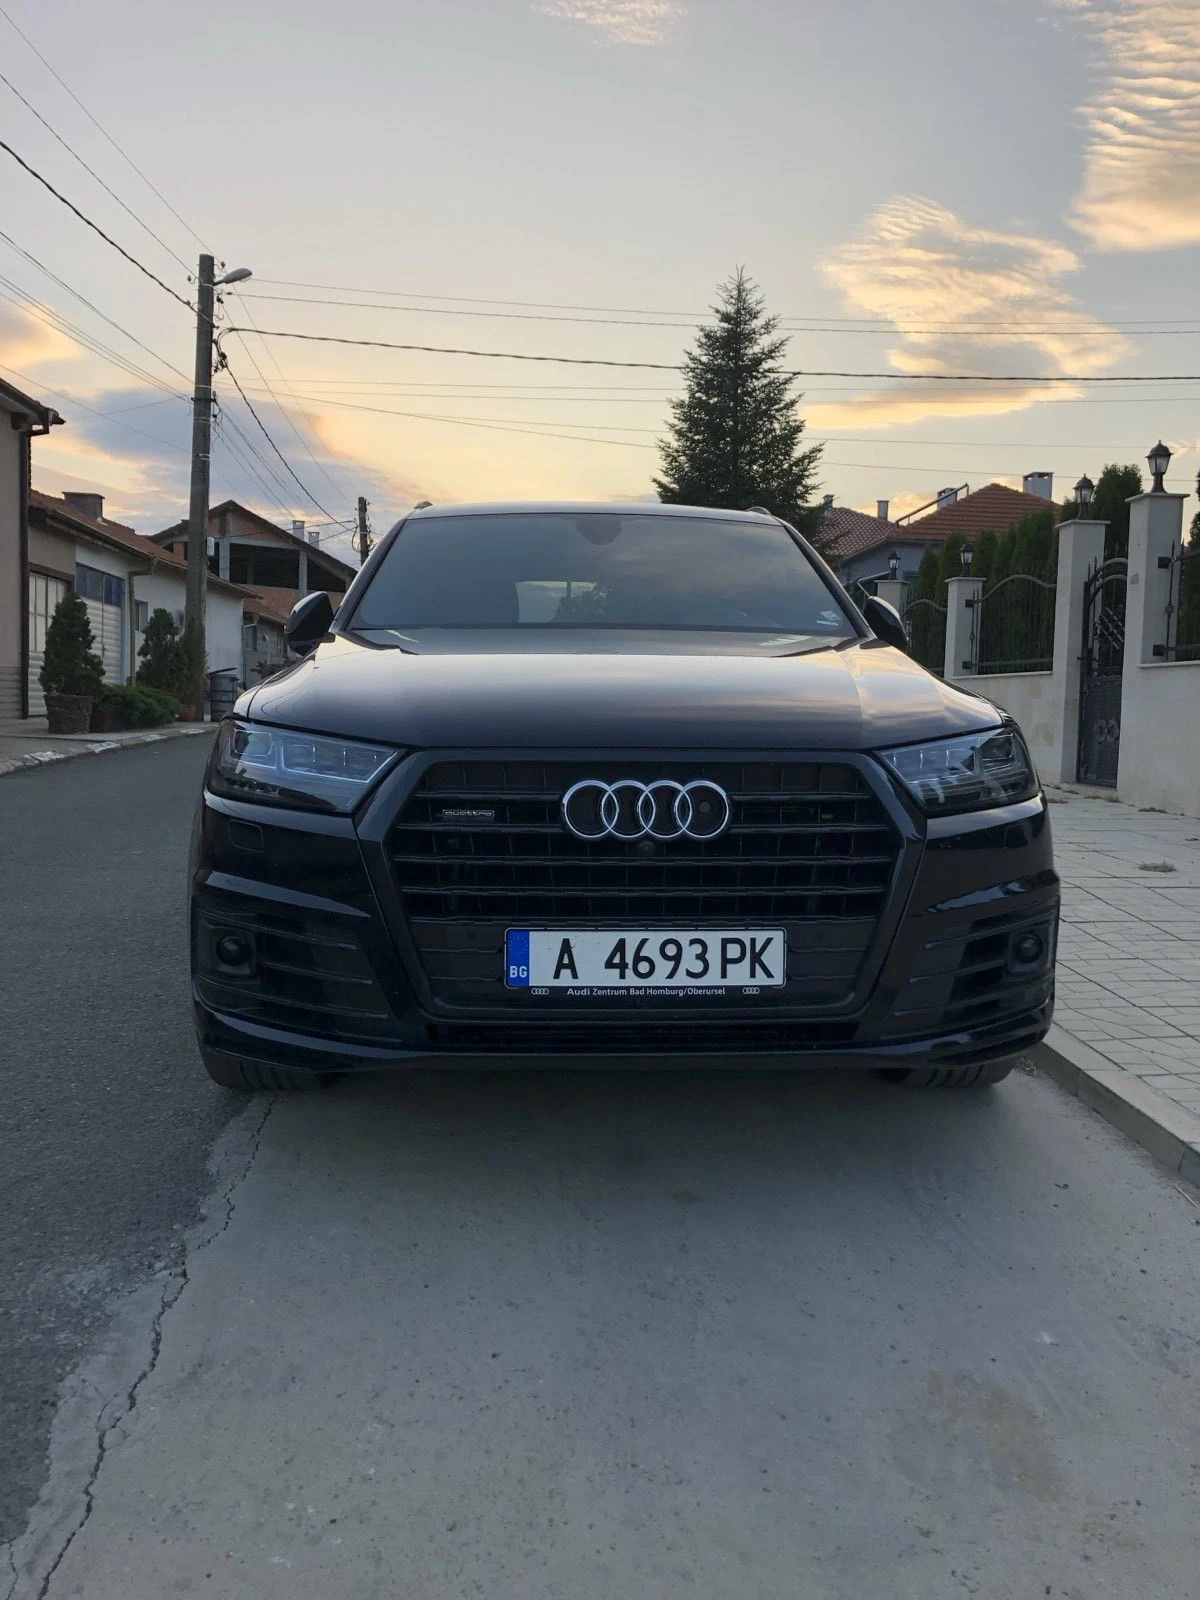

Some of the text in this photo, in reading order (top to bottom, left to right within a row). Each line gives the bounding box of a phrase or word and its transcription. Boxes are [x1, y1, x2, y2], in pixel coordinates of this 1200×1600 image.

[552, 937, 579, 980] A
[508, 965, 528, 978] BG
[566, 987, 726, 997] Audi Zentrum Bad Homburg/Oberursel
